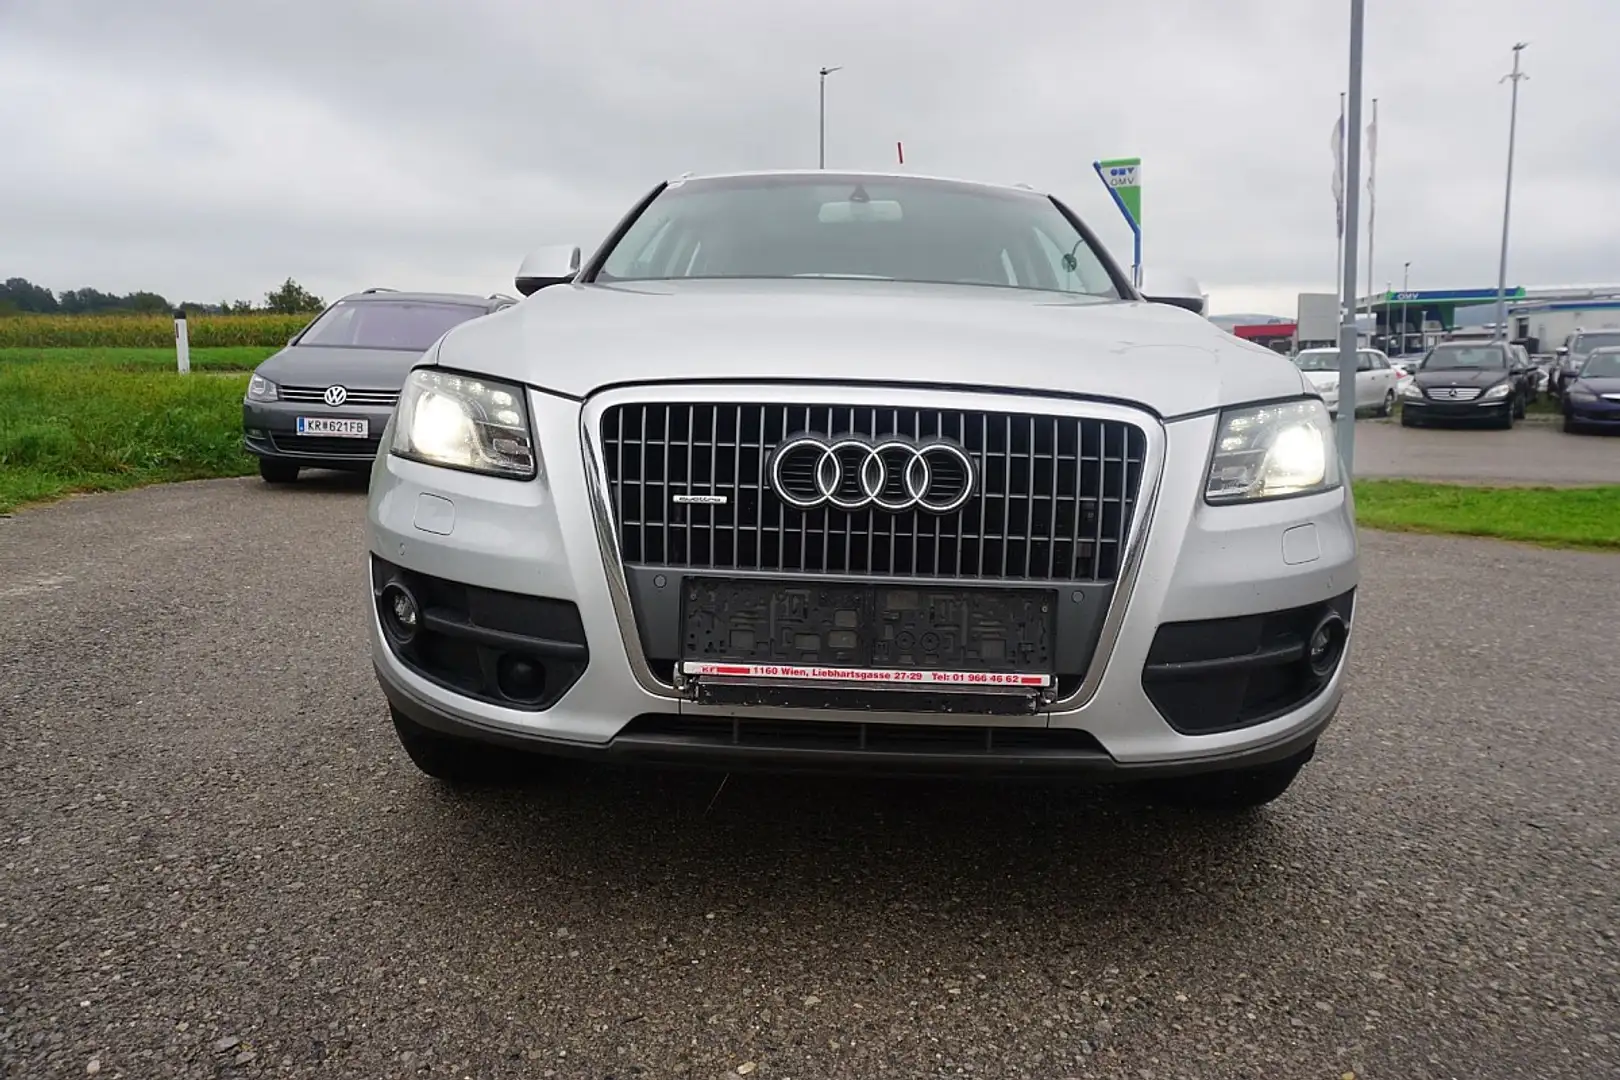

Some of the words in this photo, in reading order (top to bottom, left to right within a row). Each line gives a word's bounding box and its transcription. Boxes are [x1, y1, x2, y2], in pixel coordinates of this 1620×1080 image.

[1110, 177, 1134, 186] OMV
[307, 419, 321, 431] KR
[329, 421, 363, 433] 621FB
[753, 666, 778, 675] 1160
[781, 667, 809, 677] Wien,
[812, 668, 891, 680] Liebhartsgasse
[894, 672, 922, 680] 27-29
[931, 672, 950, 681] Tel:
[952, 673, 965, 681] 01
[967, 673, 987, 682] 966
[989, 675, 1003, 683] 46
[1005, 675, 1019, 683] 62
